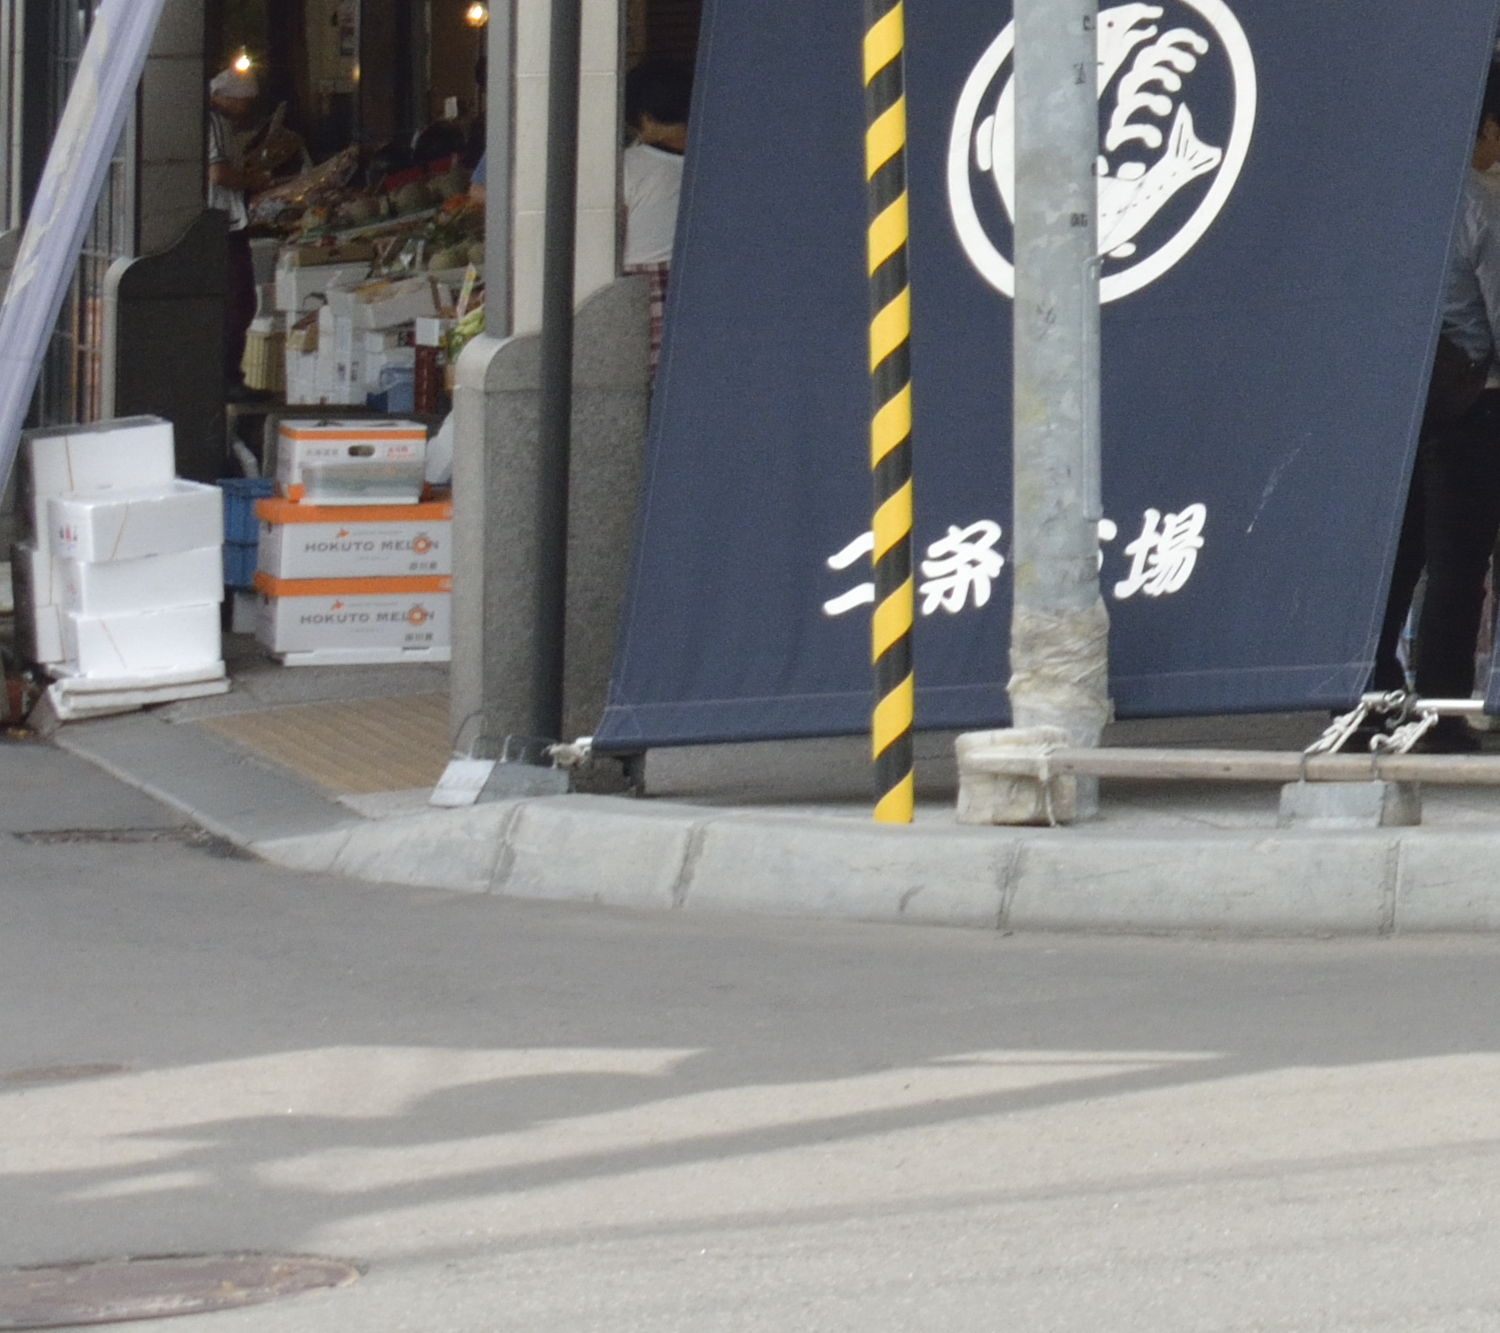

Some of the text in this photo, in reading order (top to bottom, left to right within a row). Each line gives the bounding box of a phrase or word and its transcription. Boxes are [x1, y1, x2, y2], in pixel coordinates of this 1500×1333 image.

[304, 539, 376, 554] HOKUTO
[822, 503, 1208, 616] 二条場
[299, 611, 371, 626] HOKUTO
